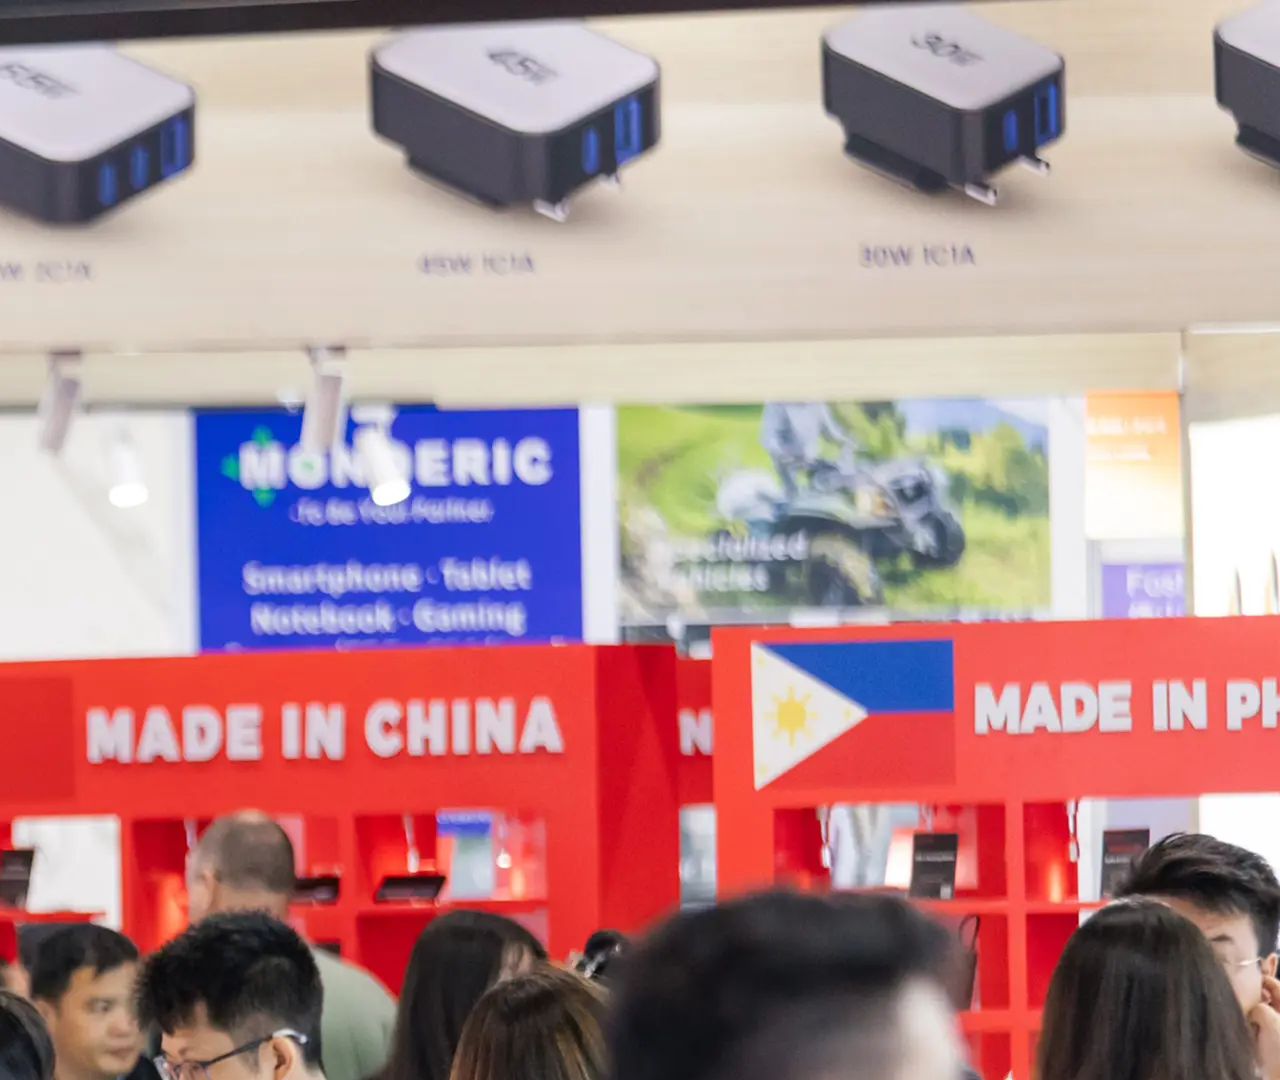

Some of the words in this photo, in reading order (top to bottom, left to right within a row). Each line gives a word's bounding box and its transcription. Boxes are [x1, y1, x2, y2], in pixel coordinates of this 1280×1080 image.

[858, 243, 913, 268] 30W
[243, 560, 423, 598] Smartphone
[440, 557, 532, 591] Tablet
[250, 600, 397, 635] Notebook
[413, 598, 527, 637] Gaming
[974, 681, 1133, 735] MADE
[1152, 678, 1208, 731] IN
[86, 705, 264, 763] MADE
[281, 702, 347, 760] IN
[363, 696, 566, 758] CHINA
